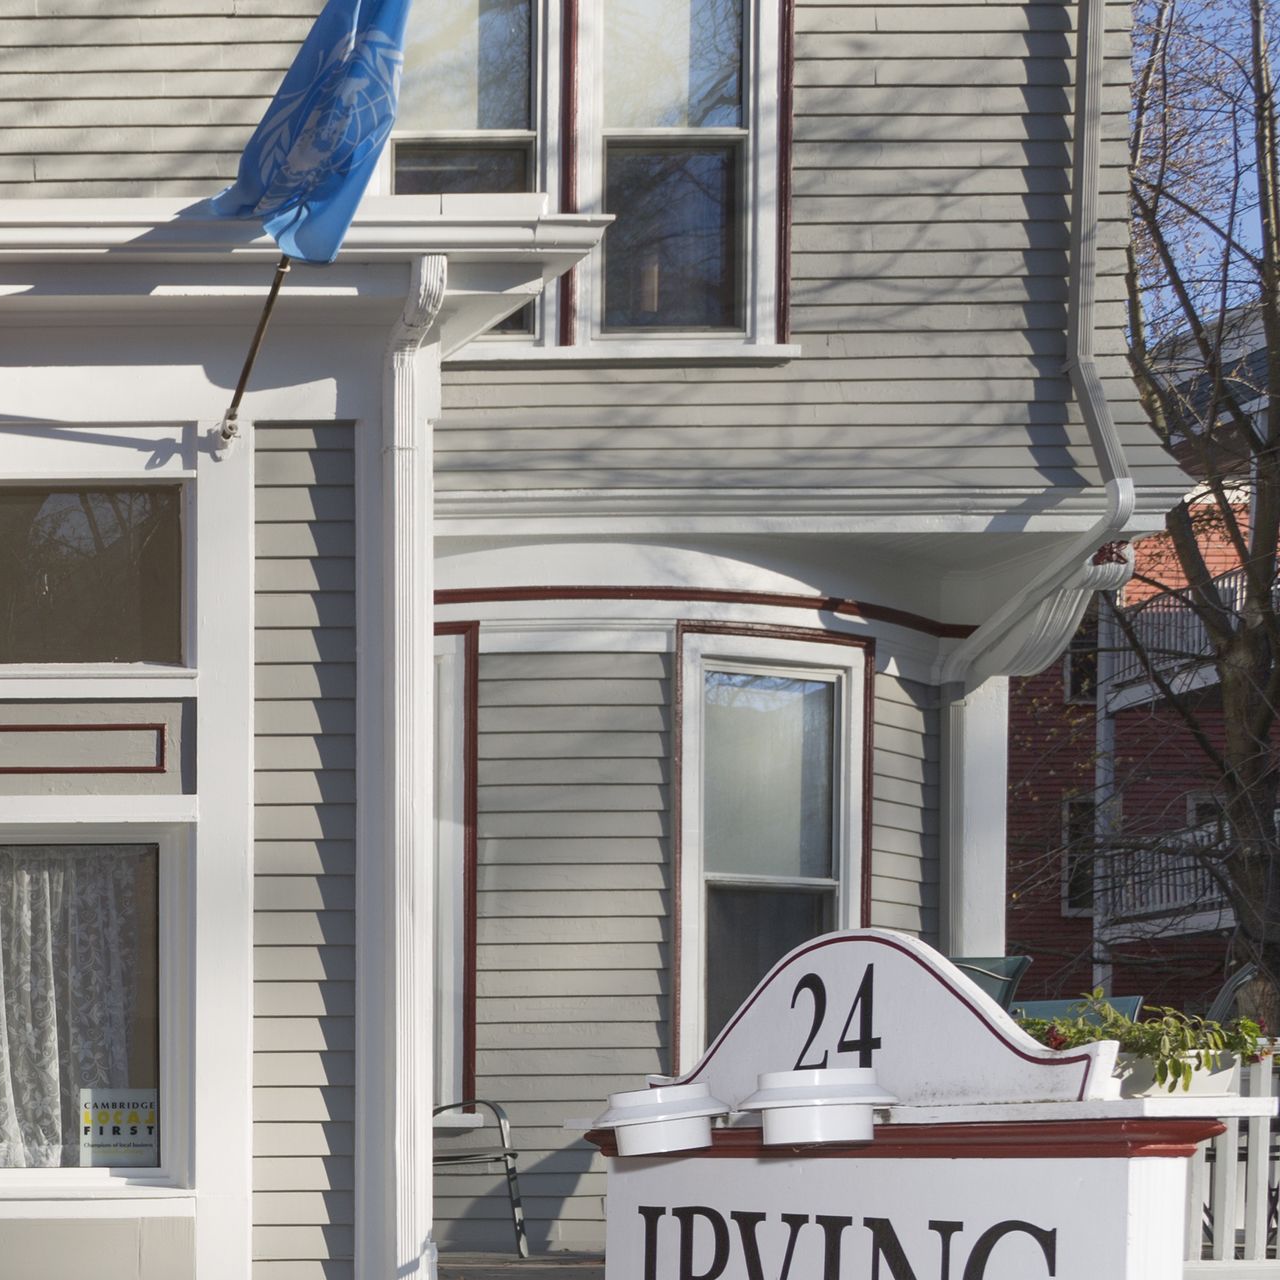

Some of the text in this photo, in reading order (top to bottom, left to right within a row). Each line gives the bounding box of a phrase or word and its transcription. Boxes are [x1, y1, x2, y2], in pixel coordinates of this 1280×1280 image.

[790, 963, 882, 1071] 24
[83, 1101, 155, 1110] CAMBRIDGE
[83, 1110, 156, 1125] LOCAL
[83, 1126, 155, 1136] FIRST
